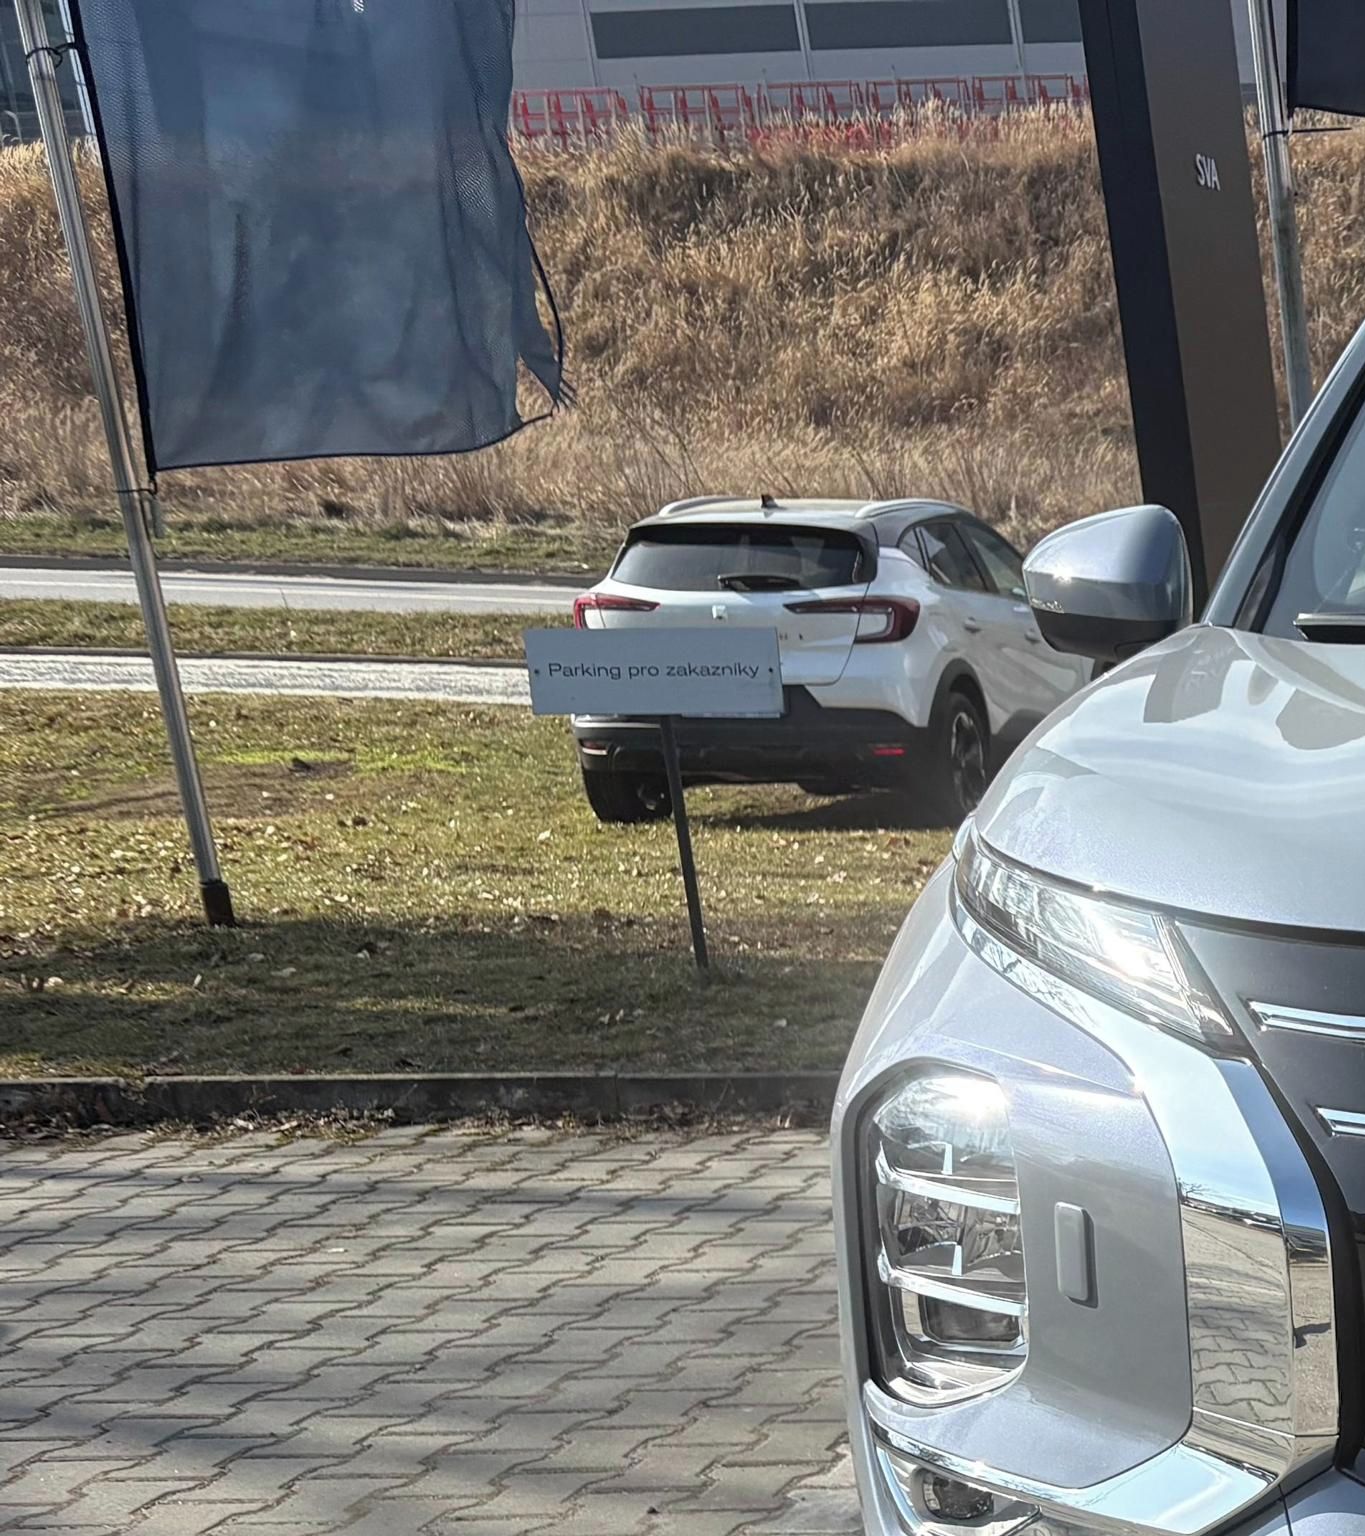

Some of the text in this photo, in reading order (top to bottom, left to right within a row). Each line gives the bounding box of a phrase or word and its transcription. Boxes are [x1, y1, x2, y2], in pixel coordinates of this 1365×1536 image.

[1195, 153, 1221, 191] SVA
[548, 662, 621, 680] Parking
[628, 665, 660, 680] pro
